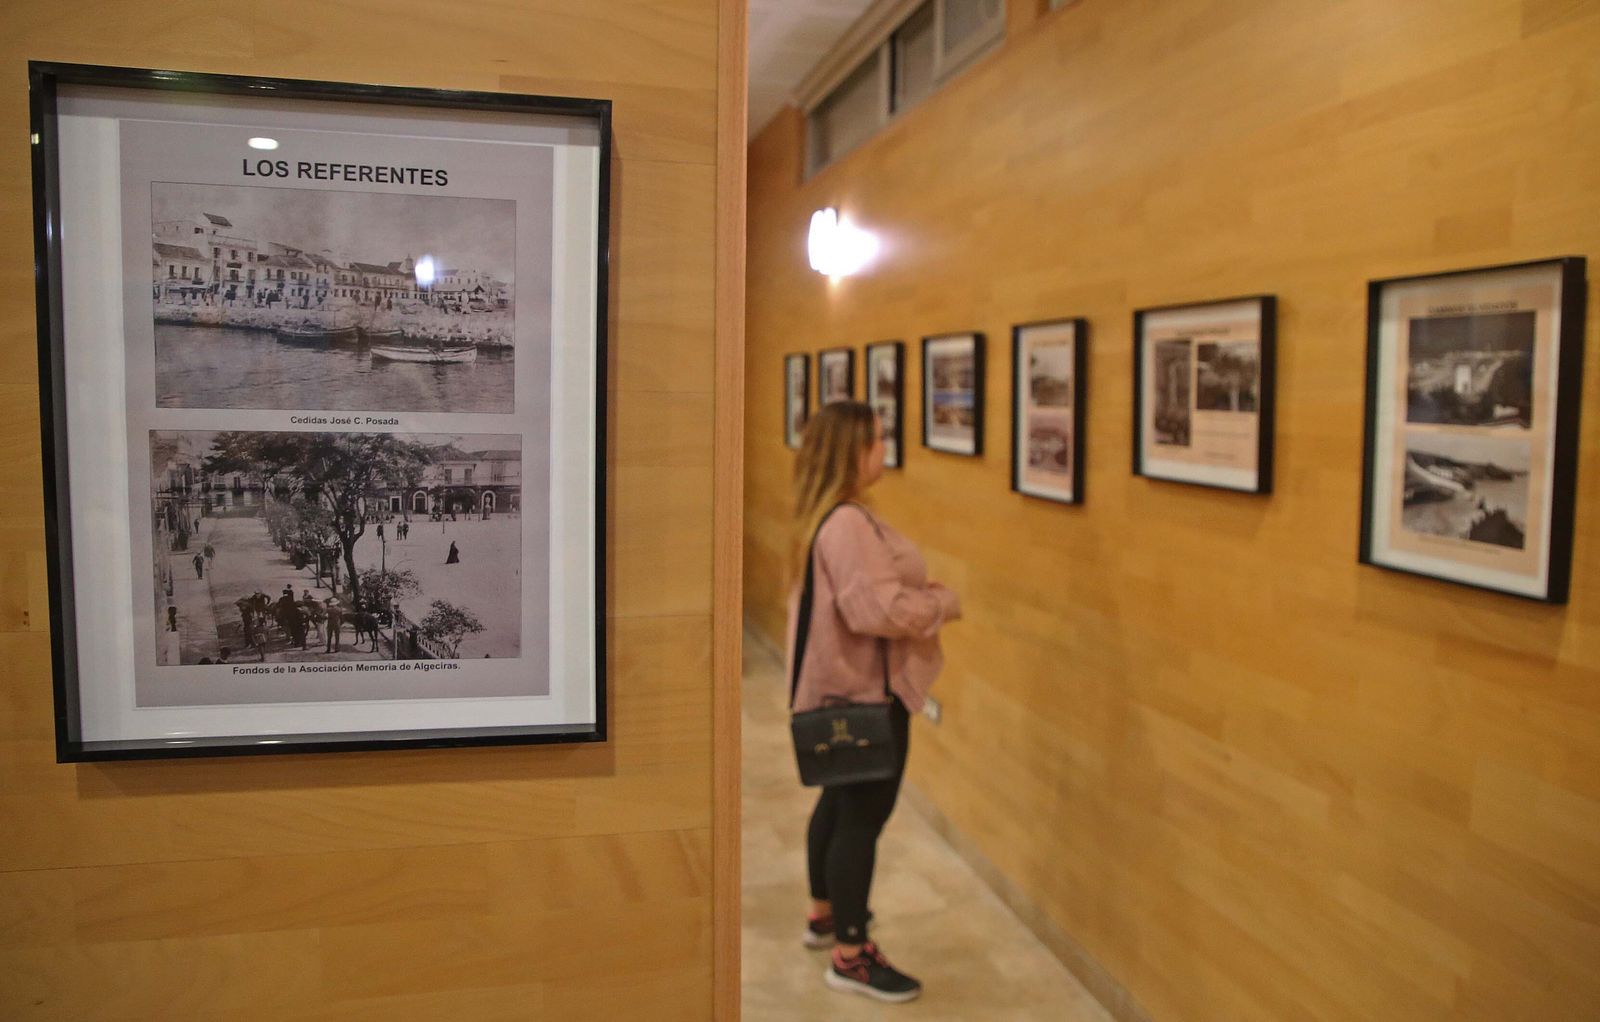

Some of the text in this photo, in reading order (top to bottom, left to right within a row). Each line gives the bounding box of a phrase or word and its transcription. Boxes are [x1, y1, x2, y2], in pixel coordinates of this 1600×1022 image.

[243, 159, 448, 186] LOS REFERENTES
[290, 416, 327, 424] Cedidas
[330, 416, 351, 424] José
[366, 417, 399, 425] Posada
[233, 662, 461, 675] Fondos de la Asociación Memoria de Algeciras.
